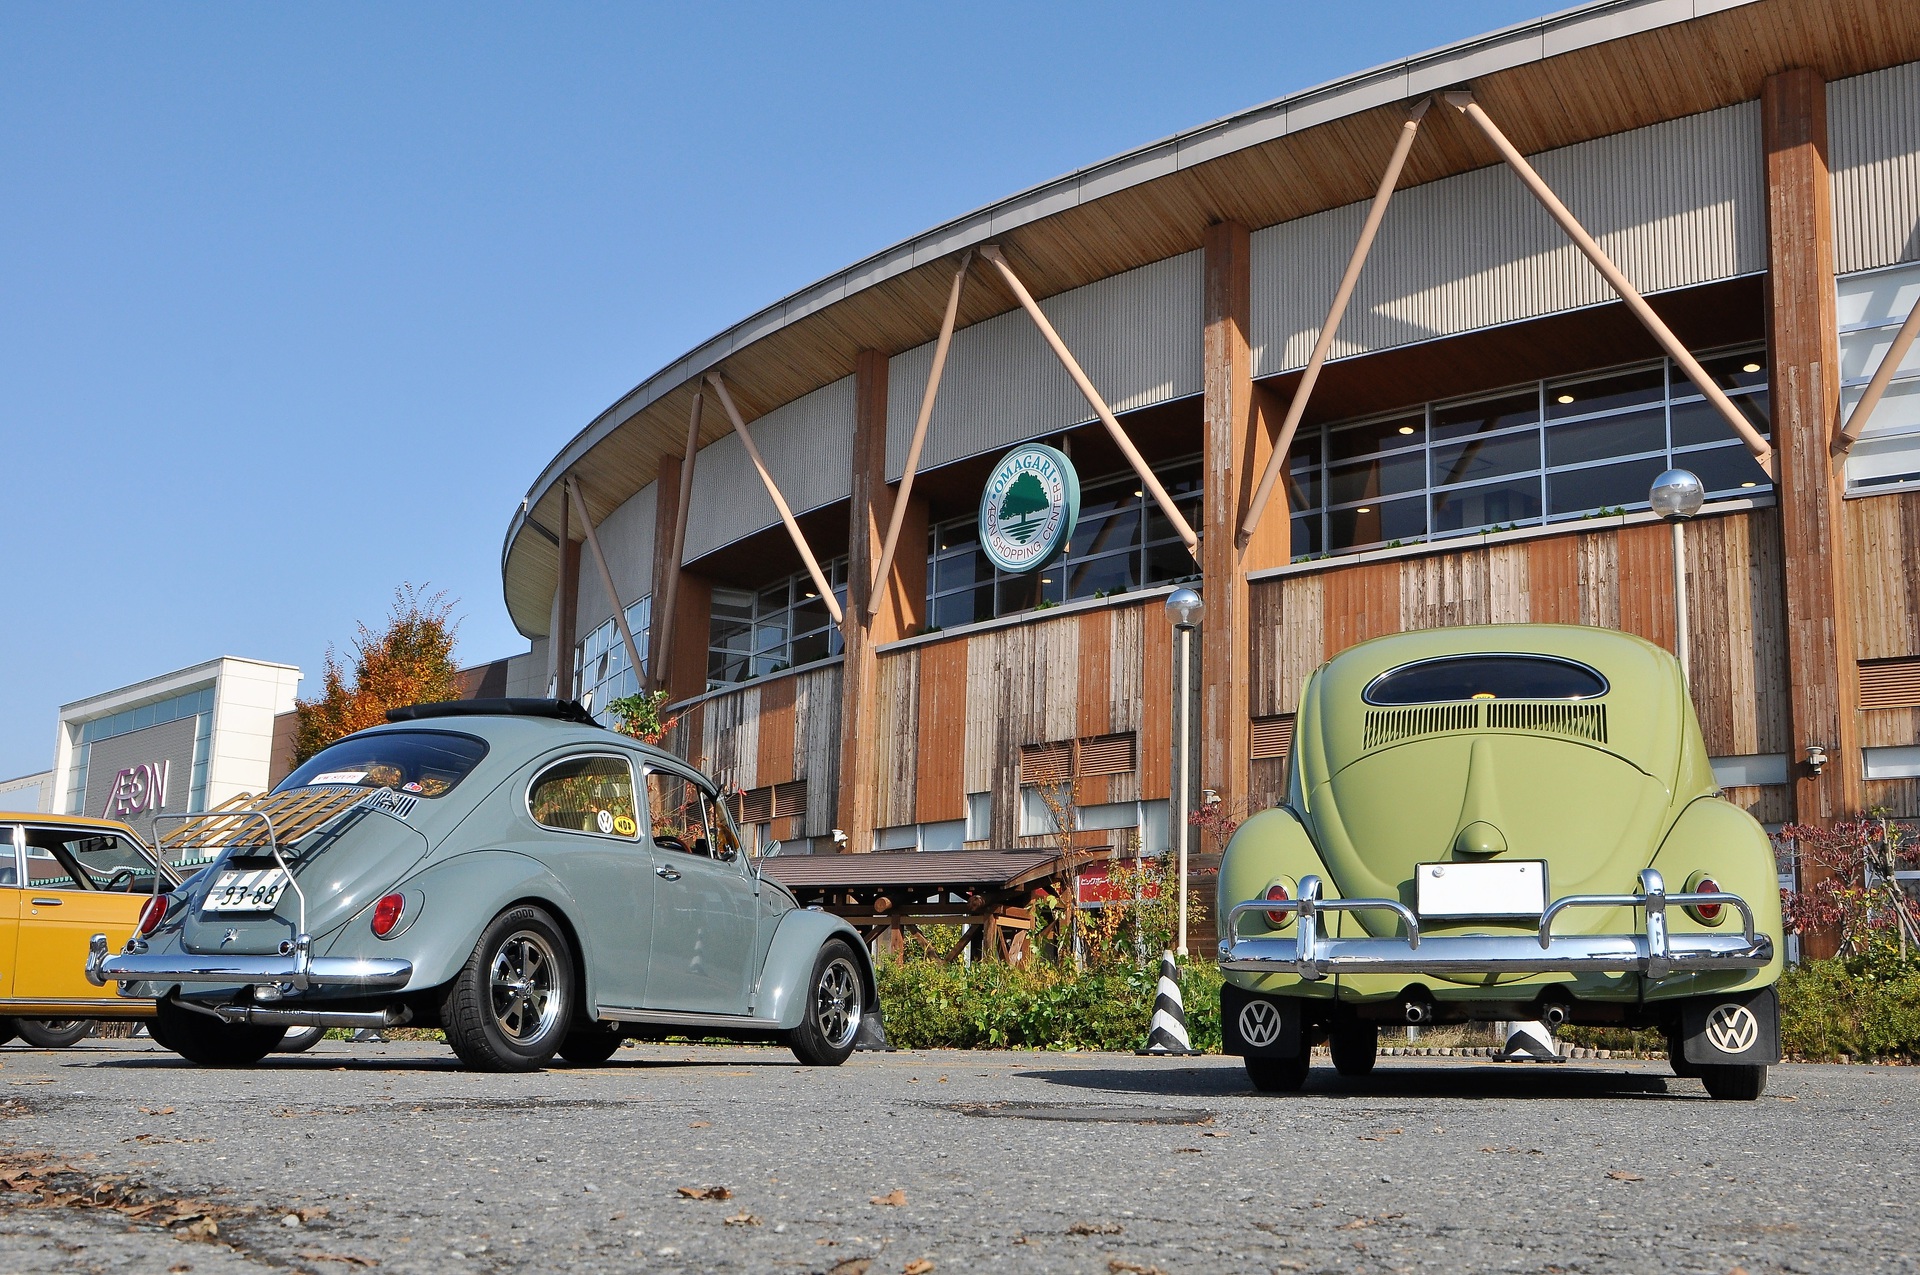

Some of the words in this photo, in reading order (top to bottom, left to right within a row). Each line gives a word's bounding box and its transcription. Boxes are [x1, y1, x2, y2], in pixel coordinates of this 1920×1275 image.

[995, 455, 1056, 494] OMAGARI
[993, 536, 1042, 560] SHOPPING
[1043, 481, 1062, 540] CENTER
[221, 885, 279, 906] 93-88
